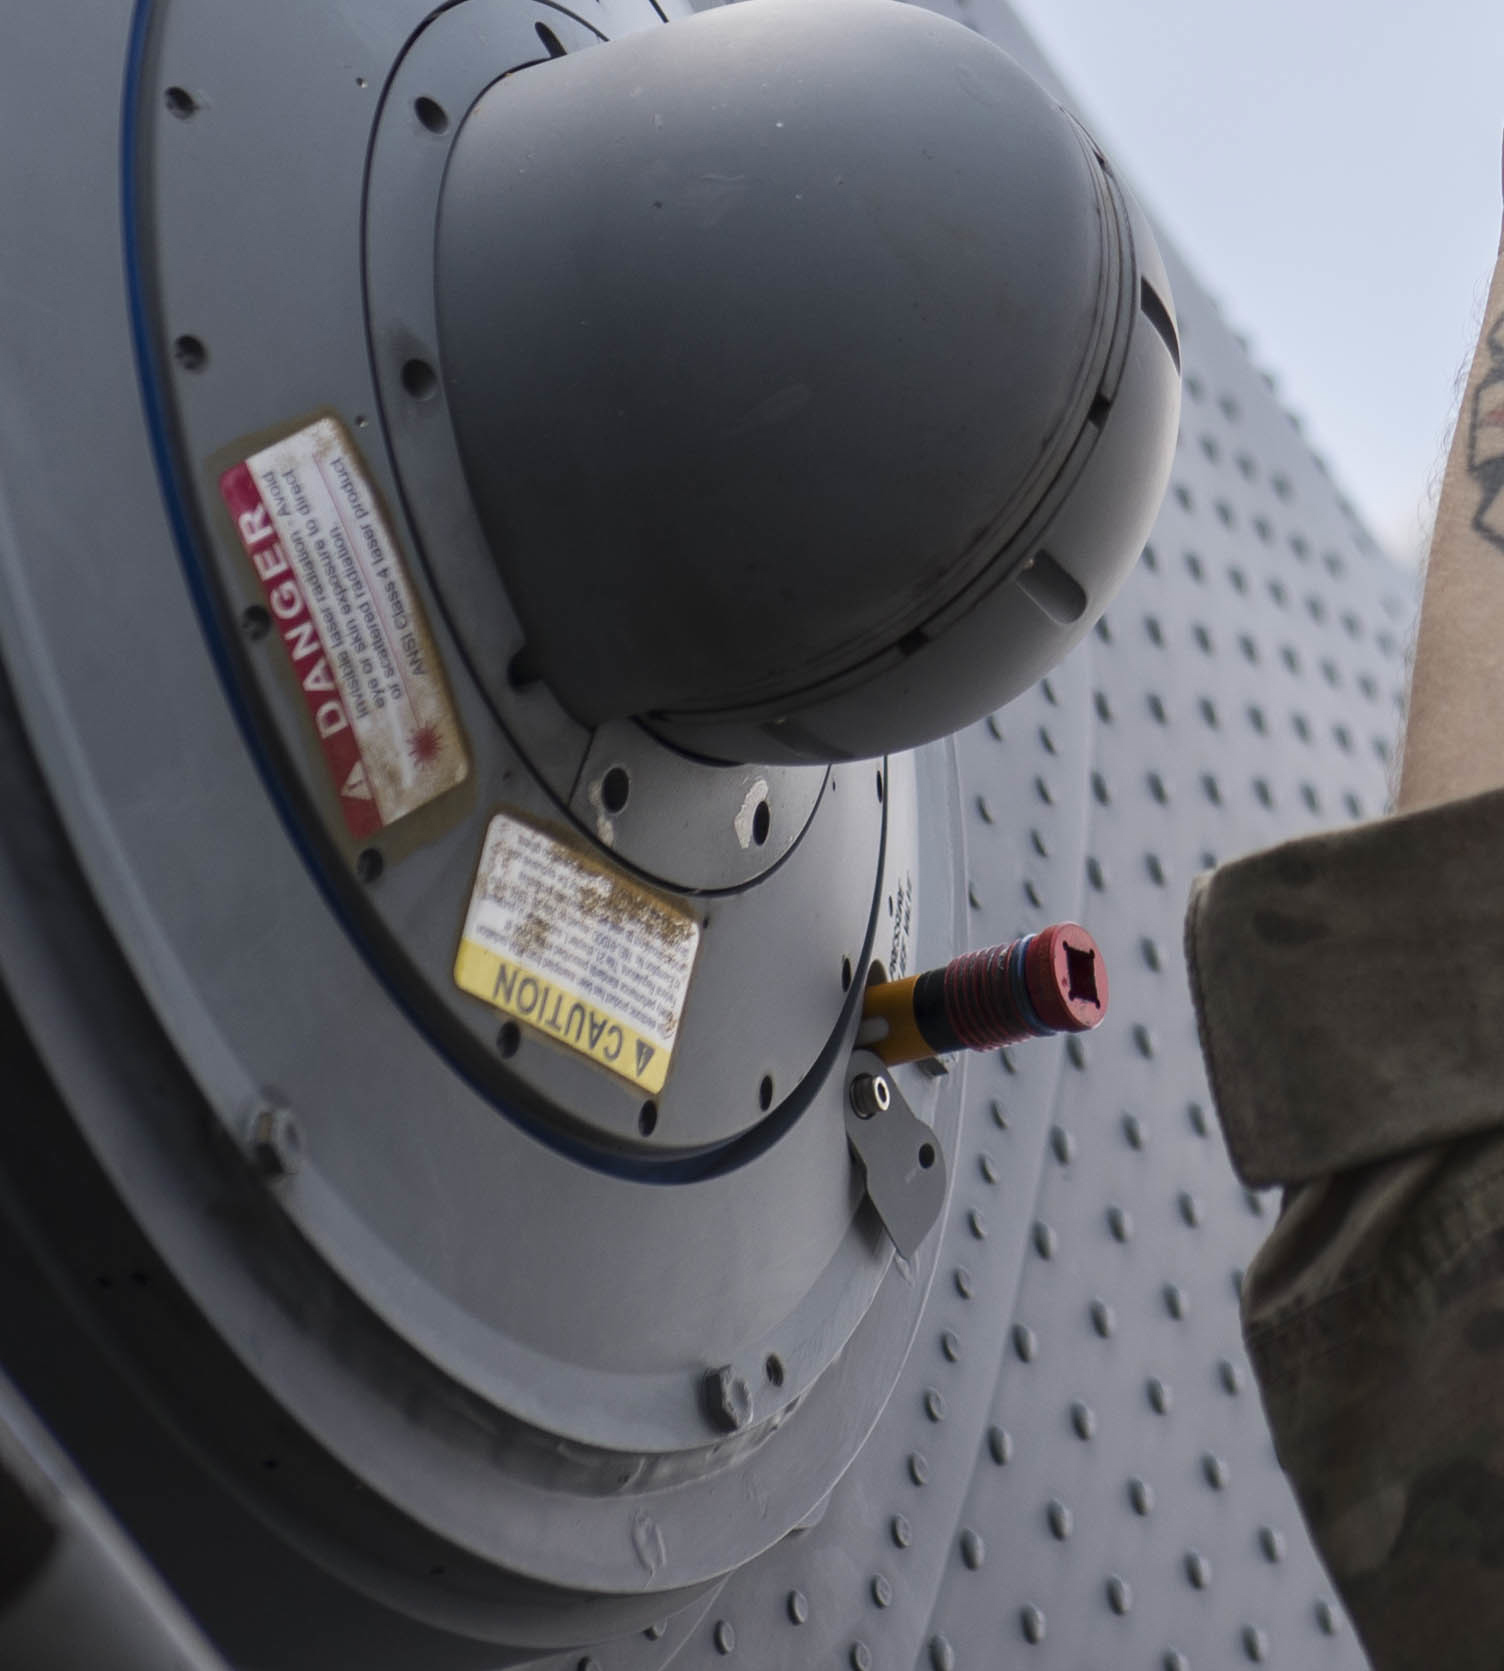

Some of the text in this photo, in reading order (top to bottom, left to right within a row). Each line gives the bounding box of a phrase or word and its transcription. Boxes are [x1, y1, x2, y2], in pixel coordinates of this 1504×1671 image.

[261, 469, 290, 521] Avoid
[281, 468, 389, 710] eye or skin exposure to direct
[286, 528, 326, 606] radiation
[328, 454, 427, 679] ANSI Class 4 laser product
[235, 500, 350, 741] DANGER
[317, 604, 343, 649] laser
[356, 600, 397, 680] scattered
[491, 960, 626, 1065] CAUTION
